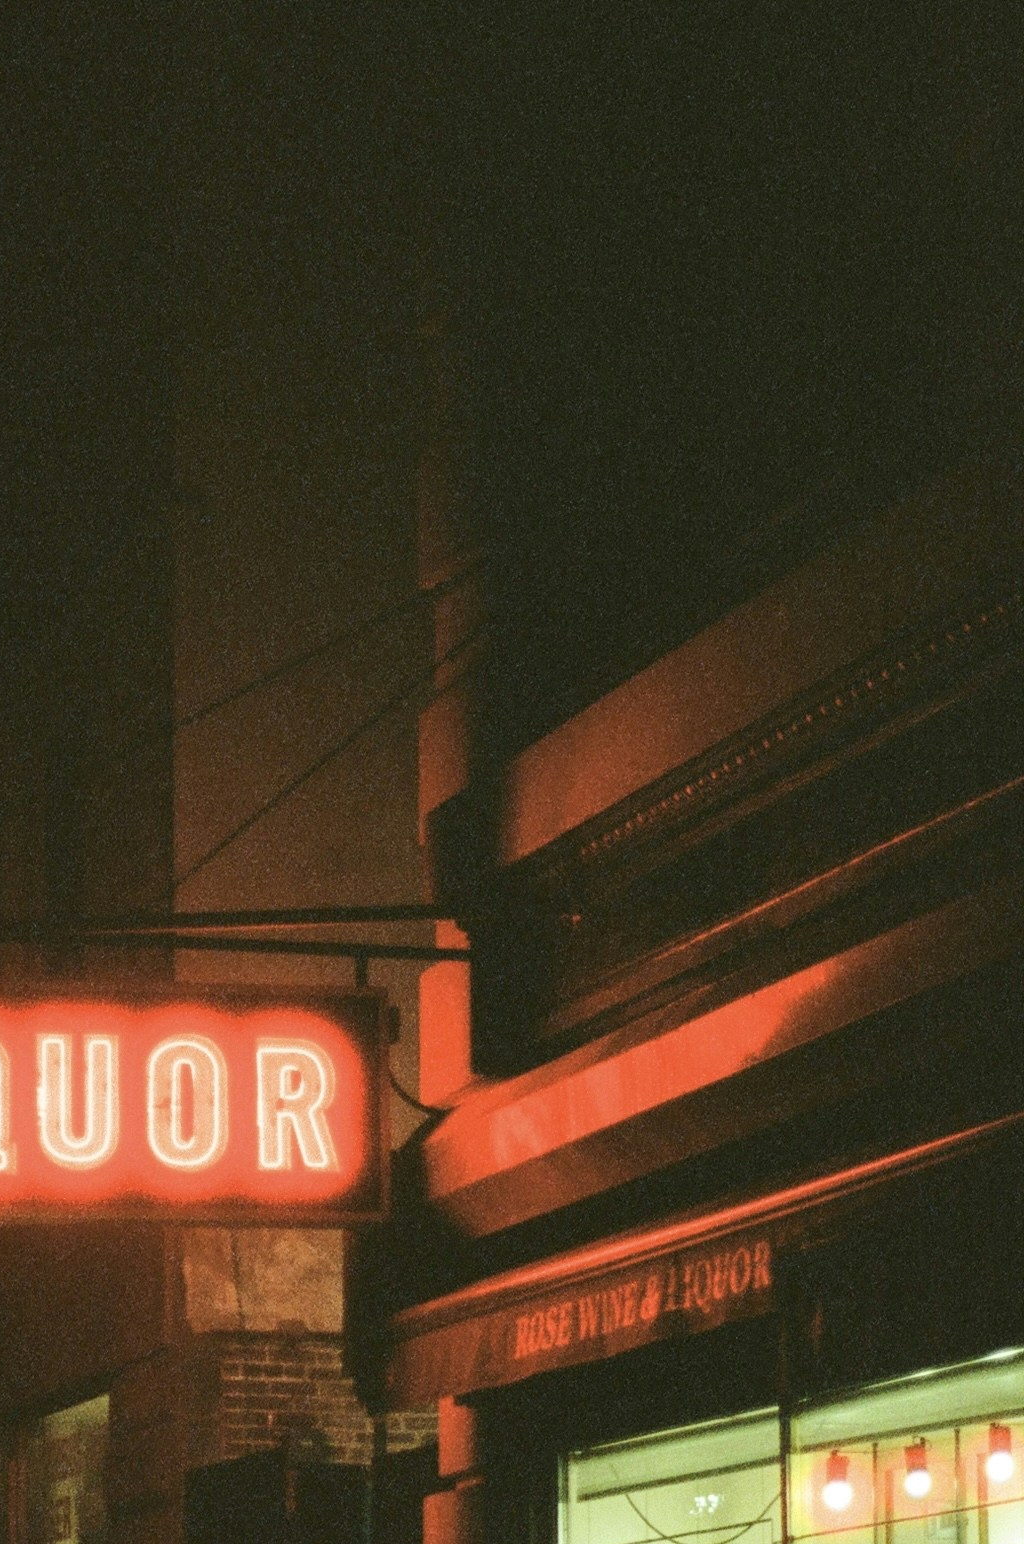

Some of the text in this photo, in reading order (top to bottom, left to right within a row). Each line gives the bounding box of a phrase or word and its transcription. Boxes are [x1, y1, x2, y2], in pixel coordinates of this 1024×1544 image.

[514, 1240, 772, 1361] ROSE WINE & LIQUOR
